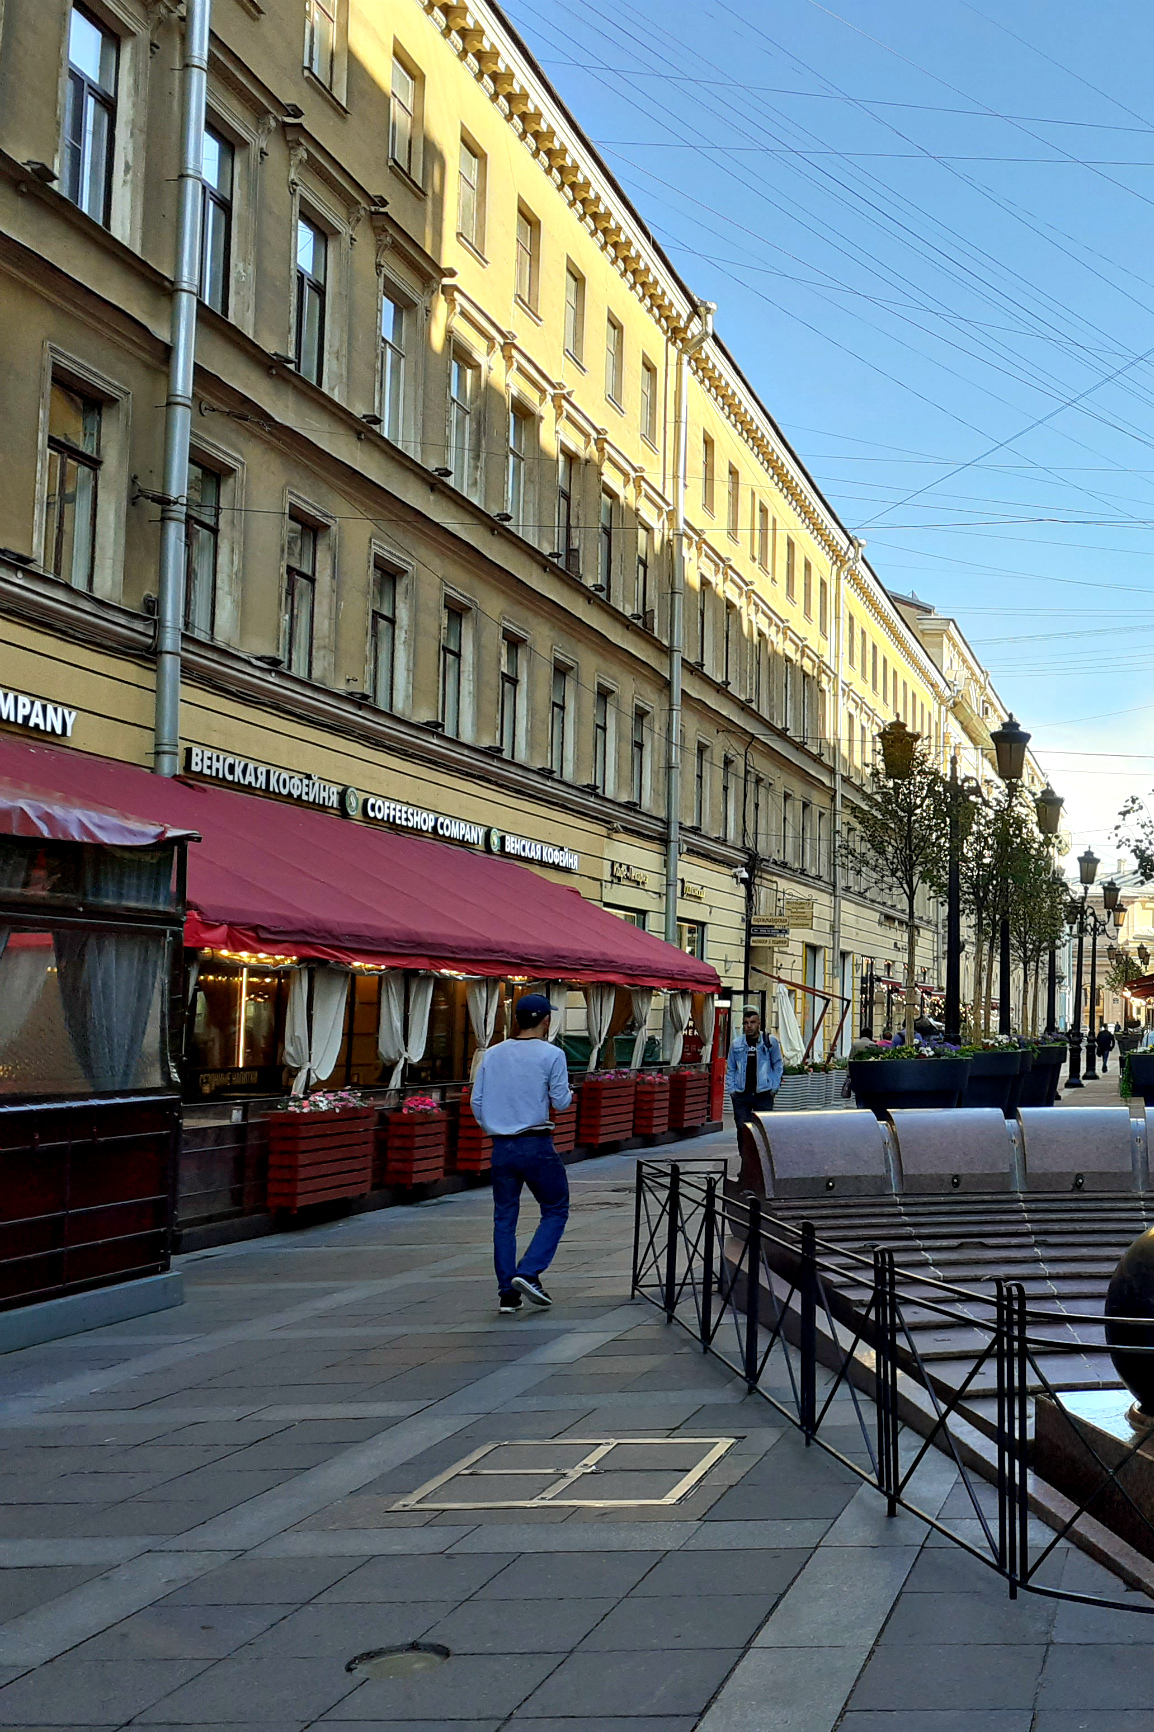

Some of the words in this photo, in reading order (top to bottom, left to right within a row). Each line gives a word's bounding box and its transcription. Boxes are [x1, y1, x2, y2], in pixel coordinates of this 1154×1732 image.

[191, 747, 266, 790] ВЕНСКАЯ
[269, 769, 338, 808] КОФЕЙНЯ
[367, 797, 435, 832] COFFEESHOP
[437, 817, 484, 846] COMPANY
[505, 835, 541, 861] ВЕНСКАЯ
[542, 847, 579, 870] КОФЕЙНЯ
